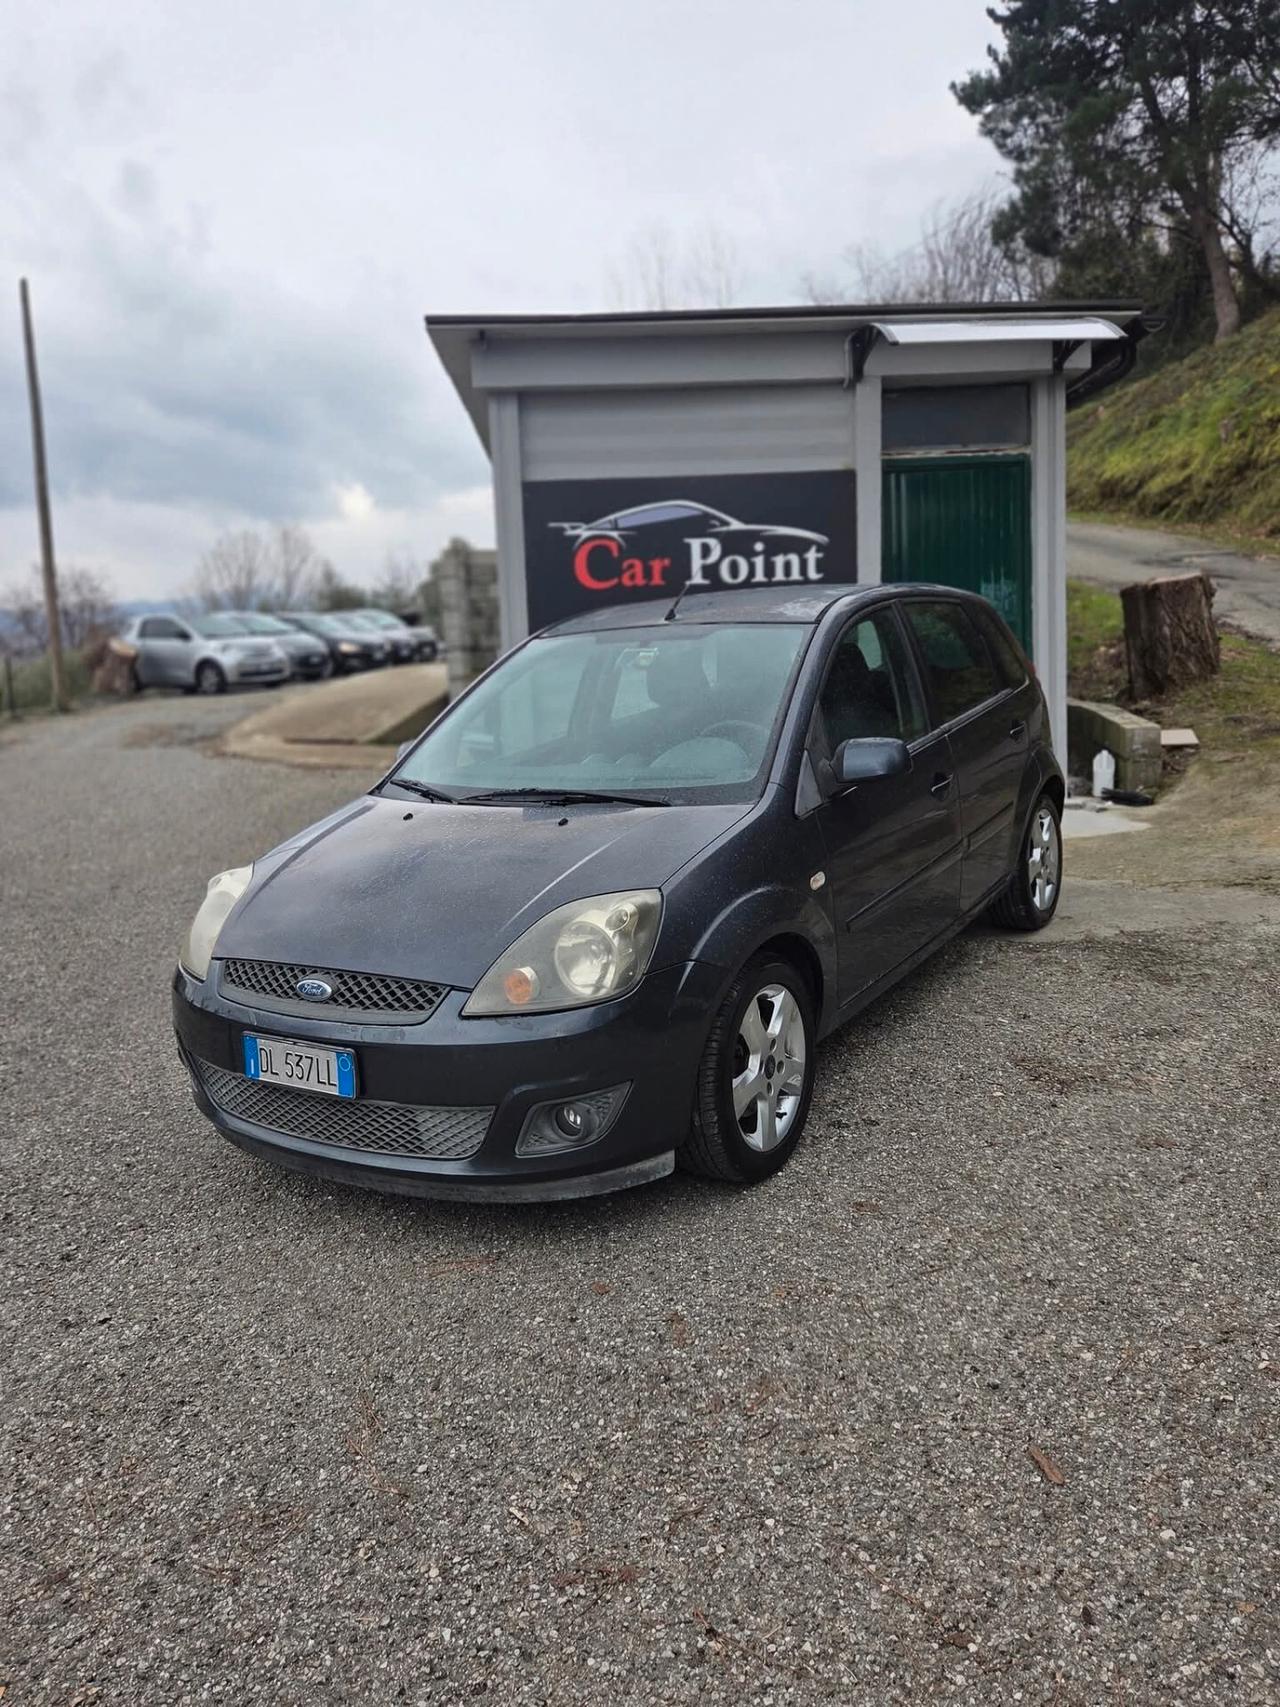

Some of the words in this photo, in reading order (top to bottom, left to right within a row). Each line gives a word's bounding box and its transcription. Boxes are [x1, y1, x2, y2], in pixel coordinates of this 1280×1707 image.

[573, 538, 671, 590] Car
[683, 537, 824, 585] Point
[302, 983, 323, 995] Ford
[259, 1047, 279, 1076] DL
[285, 1052, 338, 1087] 537LL
